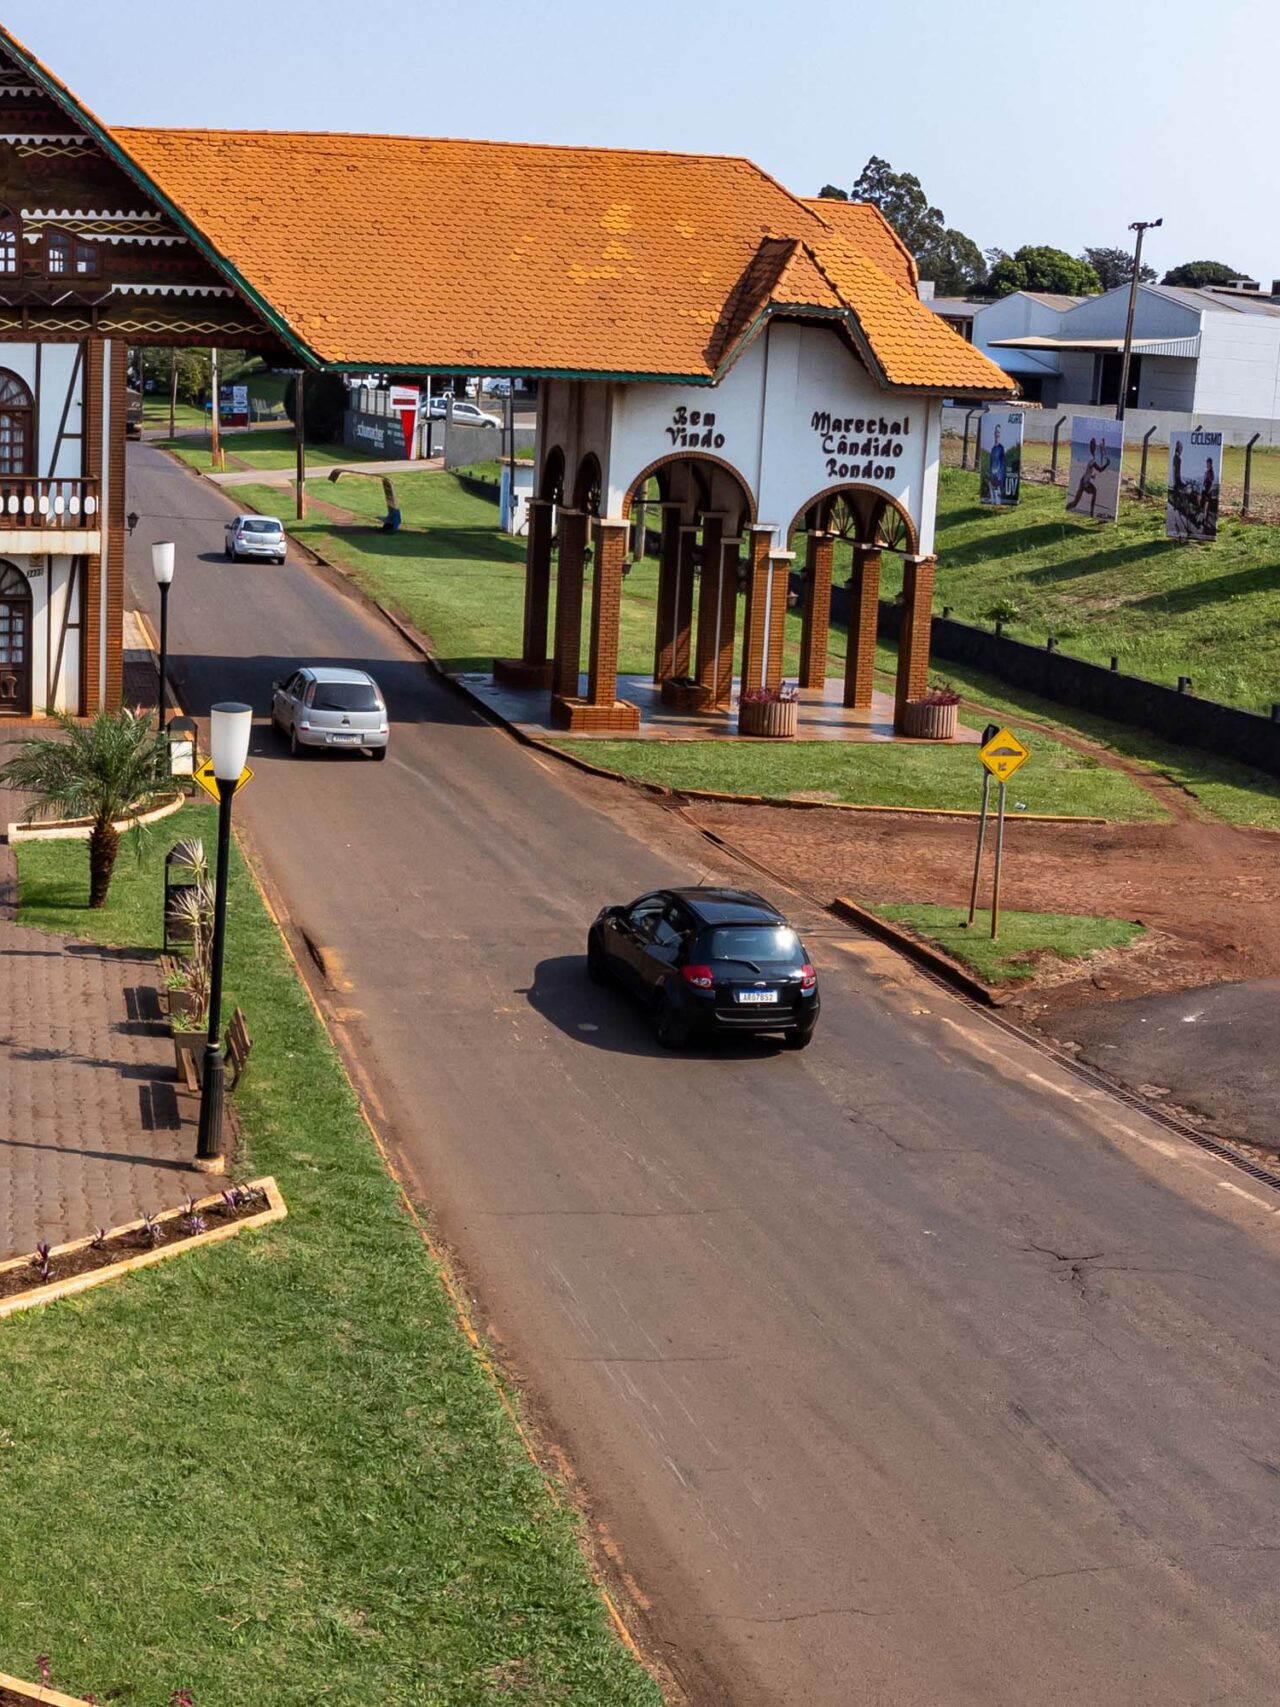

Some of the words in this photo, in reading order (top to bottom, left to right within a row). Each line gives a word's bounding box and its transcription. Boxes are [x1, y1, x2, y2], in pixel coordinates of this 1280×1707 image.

[673, 406, 716, 427] Bem
[811, 411, 910, 437] Marechal
[665, 427, 726, 449] Vindo
[822, 435, 904, 457] Cândido
[1191, 432, 1222, 446] CICLISMO
[825, 457, 896, 480] Rondon
[1005, 477, 1018, 496] UV
